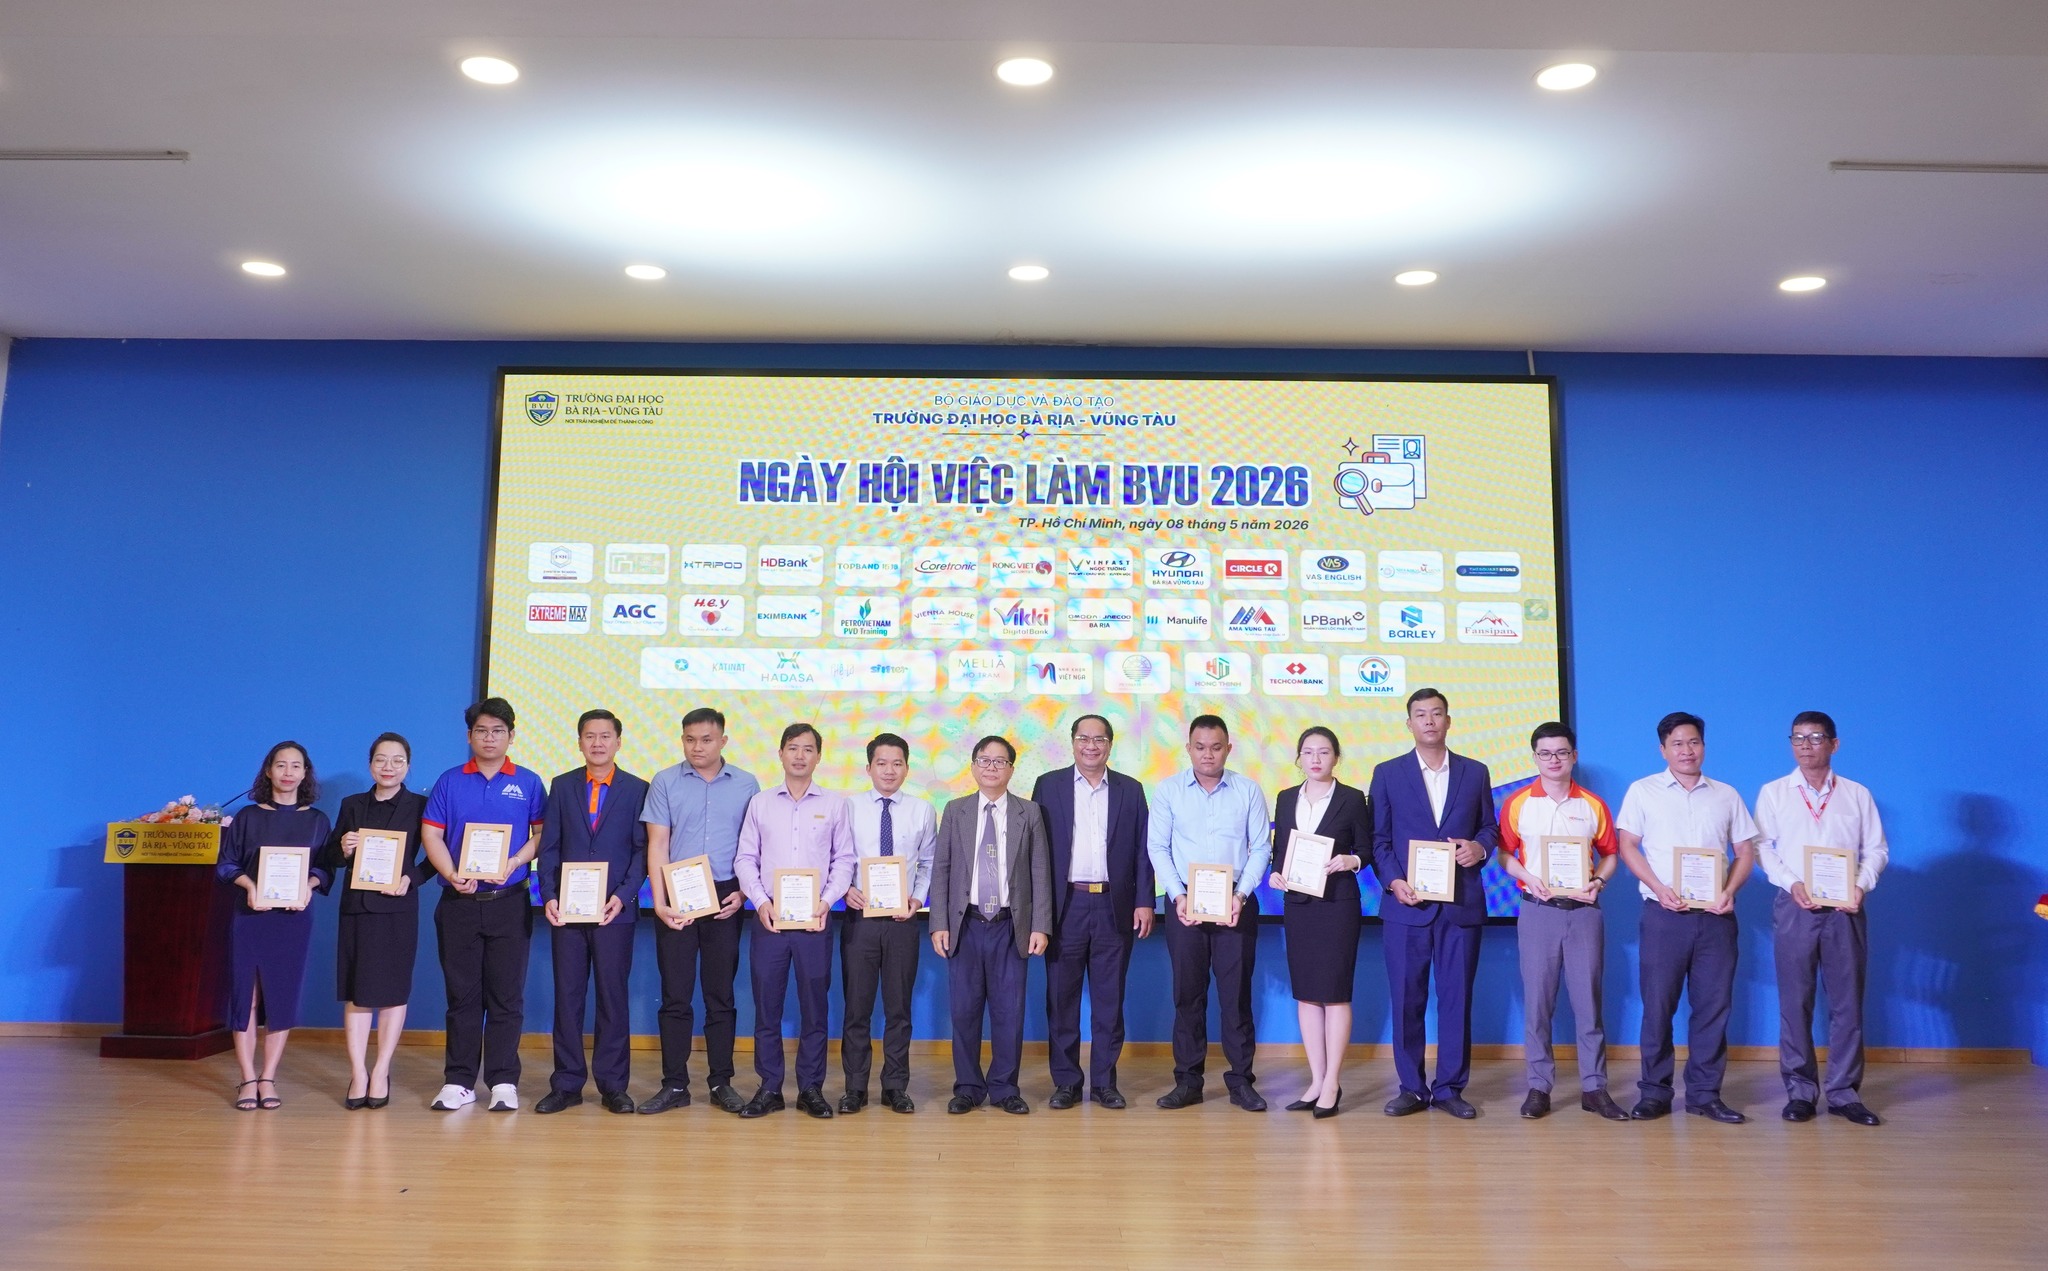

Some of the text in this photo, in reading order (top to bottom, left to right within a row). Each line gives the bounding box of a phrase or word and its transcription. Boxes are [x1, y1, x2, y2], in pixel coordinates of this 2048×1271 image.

[565, 393, 664, 405] TRƯỜNG ĐẠI HỌC
[934, 393, 1115, 410] BỘ GIÁO DỤC VÀ ĐÀO TẠO
[565, 404, 578, 415] BÀ
[582, 406, 601, 417] RỊA
[608, 405, 640, 416] VŨNG
[643, 405, 663, 416] TÀU
[873, 410, 944, 426] TRƯỜNG
[946, 412, 977, 428] ĐẠI
[980, 412, 1017, 428] HỌC
[1020, 410, 1043, 426] BÀ
[1047, 412, 1076, 428] RỊA
[1090, 410, 1139, 426] VŨNG
[1142, 410, 1177, 426] TÀU
[739, 454, 1309, 513] NGÀY HỘI VIỆC LÀM BVU 2026
[1018, 515, 1309, 532] TP. Hồ Chí Minh, ngày 08 tháng 5 năm 2026
[760, 558, 808, 568] HDBank
[920, 560, 976, 571] Coretronic
[1323, 557, 1342, 568] VAS
[1152, 570, 1204, 578] HYUNDAI
[1229, 564, 1263, 573] CIRCLE
[530, 606, 587, 621] EXTREME MAX
[613, 604, 656, 618] AGC
[914, 610, 975, 620] VIENNA HOUSE
[1167, 616, 1208, 625] Manulife
[1303, 615, 1352, 626] LPBank
[860, 628, 888, 636] Training
[1465, 627, 1513, 636] Fansipan
[713, 663, 746, 672] KATINAT
[761, 673, 814, 682] HADASA
[194, 831, 213, 840] HỌC
